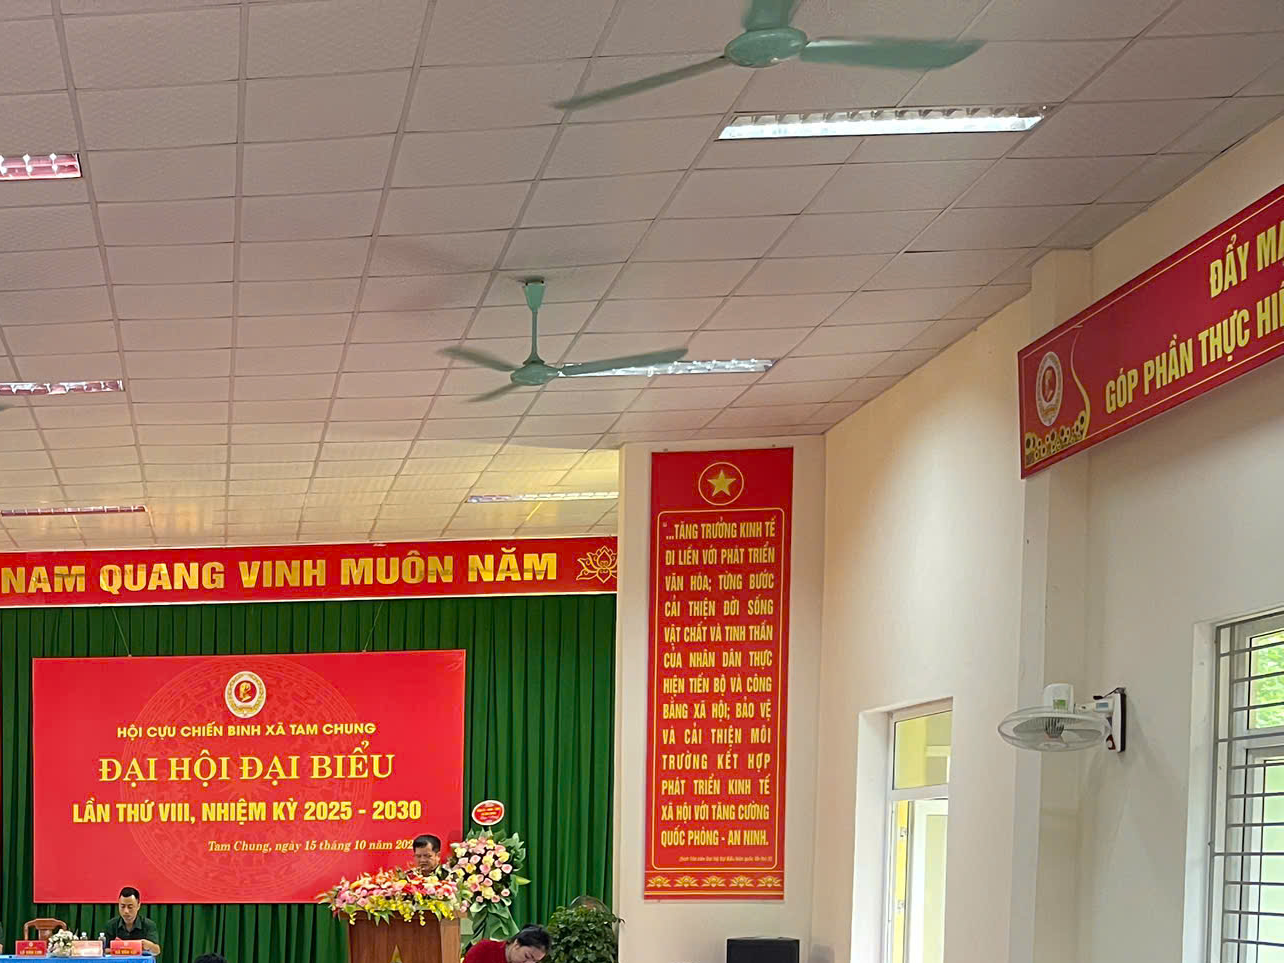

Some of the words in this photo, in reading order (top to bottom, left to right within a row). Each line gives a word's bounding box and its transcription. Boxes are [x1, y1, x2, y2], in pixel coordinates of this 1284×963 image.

[1209, 234, 1249, 298] ĐẨY
[1105, 368, 1138, 414] GÓP
[1144, 334, 1193, 395] PHẦN
[1198, 309, 1250, 366] THỰC
[1, 564, 86, 593] NAM
[99, 561, 225, 593] QUANG
[238, 559, 325, 588] VINH
[341, 550, 454, 586] MUÔN
[467, 547, 557, 581] NĂM
[117, 724, 143, 741] HỘI
[147, 725, 177, 739] CỰU
[184, 721, 223, 737] CHIẾN
[227, 725, 261, 736] BINH
[265, 722, 286, 735] XÃ
[290, 724, 318, 735] TAM
[323, 723, 376, 735] CHUNG
[99, 758, 157, 788] ĐẠI
[168, 750, 230, 787] HỘI
[239, 756, 300, 786] ĐẠI
[311, 740, 395, 780] BIỂU
[73, 797, 110, 823] LẦN
[116, 801, 154, 822] THỨ
[159, 804, 195, 824] VIII,
[202, 799, 266, 825] NHIỆM
[272, 798, 297, 820] KỲ
[304, 801, 352, 820] 2025
[372, 800, 421, 820] 2030
[208, 841, 231, 851] Tam
[234, 840, 272, 853] Chung,
[275, 841, 301, 853] ngày
[305, 841, 316, 850] 15
[319, 840, 351, 852] tháng
[354, 840, 366, 850] 10
[368, 840, 393, 850] năm
[395, 840, 414, 850] 202
